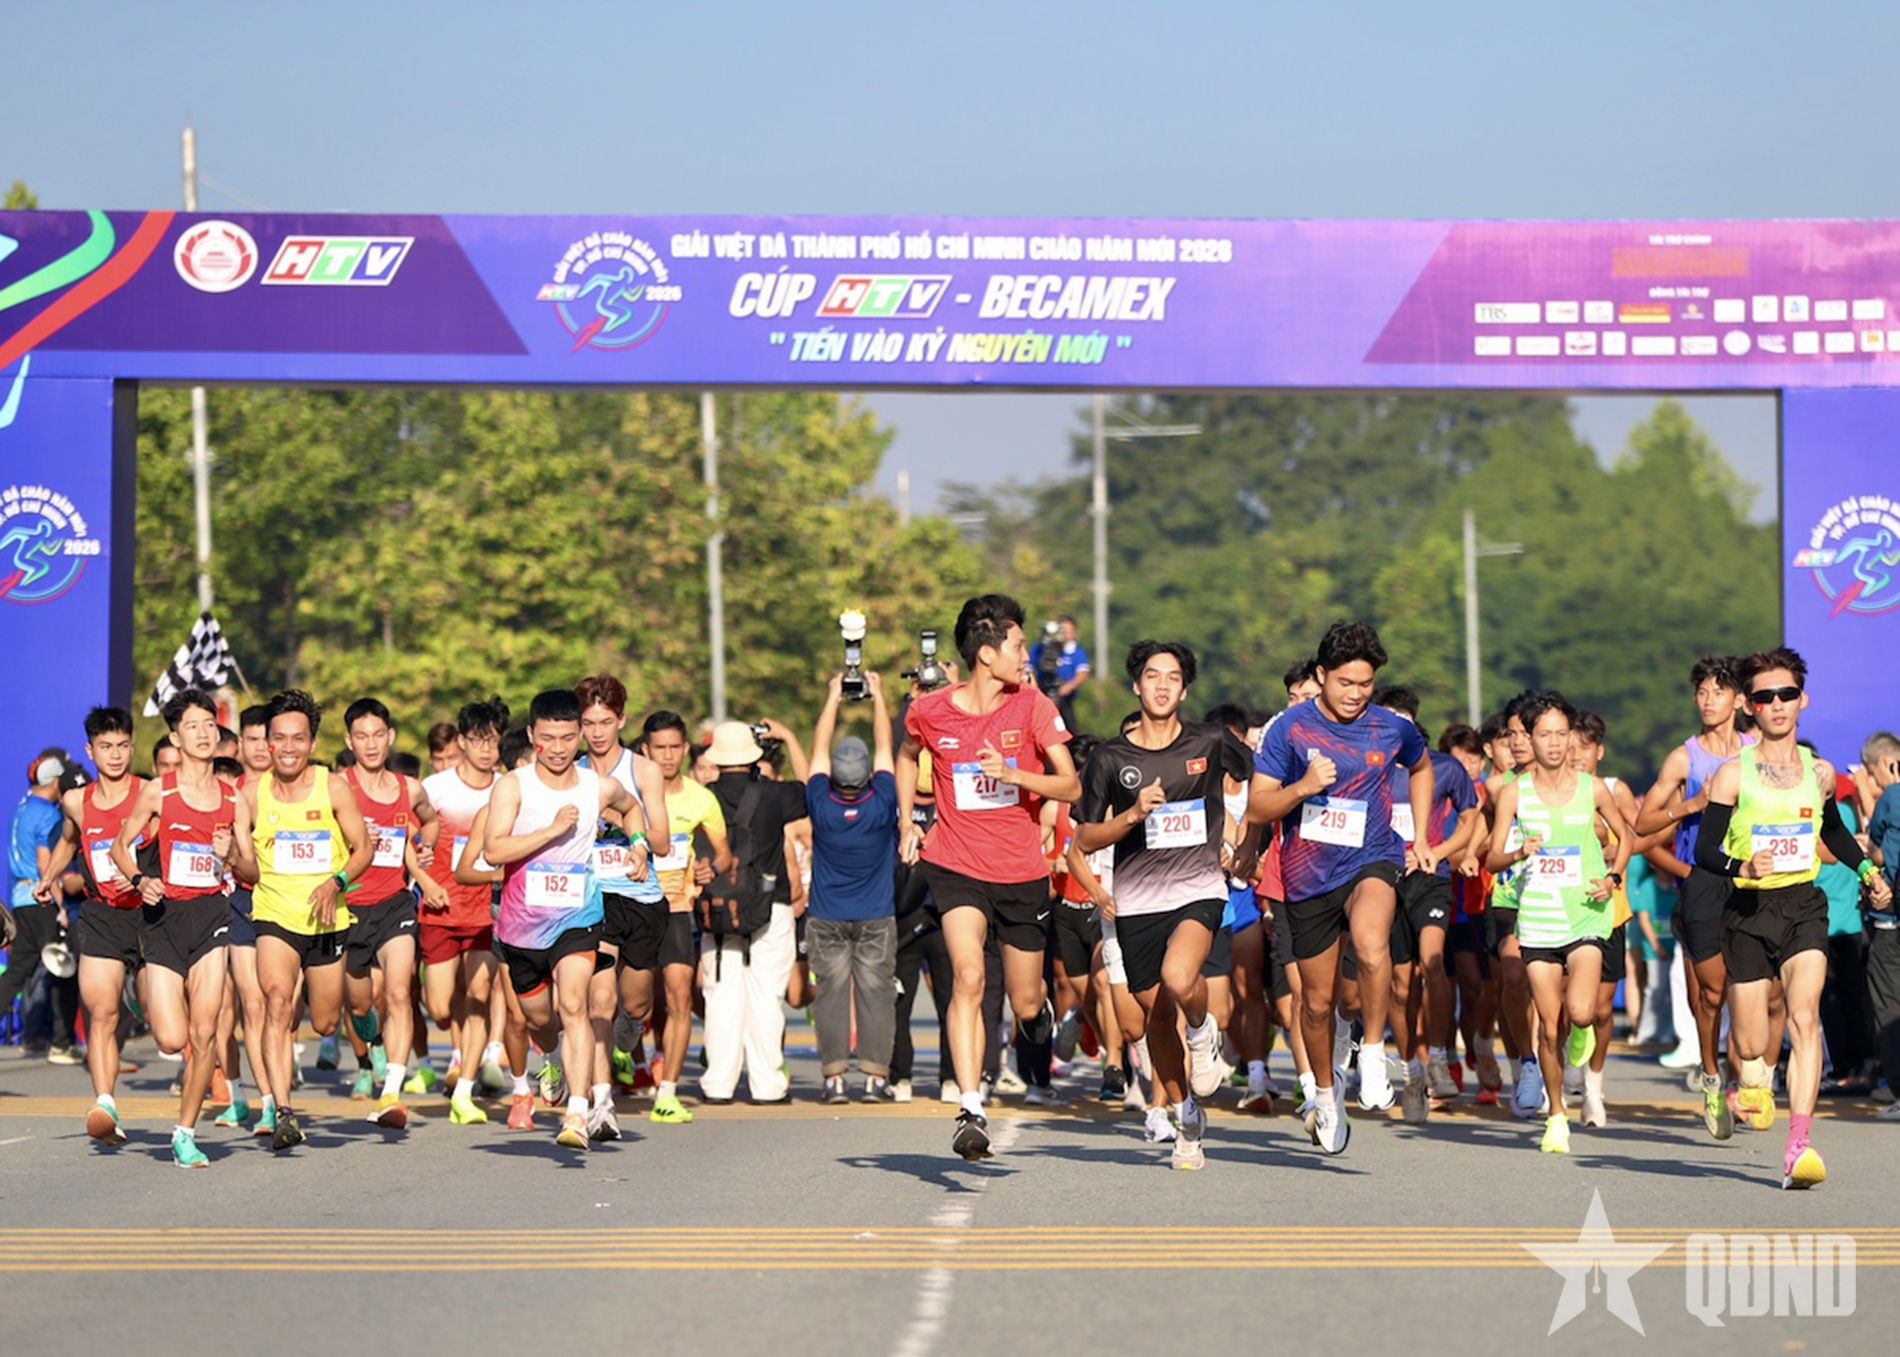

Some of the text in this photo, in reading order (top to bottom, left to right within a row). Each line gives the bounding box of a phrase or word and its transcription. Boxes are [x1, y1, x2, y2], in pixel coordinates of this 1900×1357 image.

[713, 231, 756, 262] VIỆT
[272, 245, 404, 278] HTV
[729, 265, 816, 318] CÚP
[824, 281, 942, 311] HTV
[978, 275, 1177, 321] BECAMEX
[789, 325, 848, 361] TIẾN
[850, 328, 904, 362] VÀO
[945, 329, 1054, 363] NGUYÊN
[1053, 329, 1109, 364] MỚI
[972, 775, 998, 793] 217
[1162, 814, 1191, 833] 220
[1320, 810, 1347, 829] 219
[291, 843, 315, 859] 153
[1769, 837, 1798, 856] 236
[190, 856, 213, 872] 168
[599, 849, 621, 865] 154
[1540, 858, 1565, 874] 229
[544, 875, 569, 892] 152
